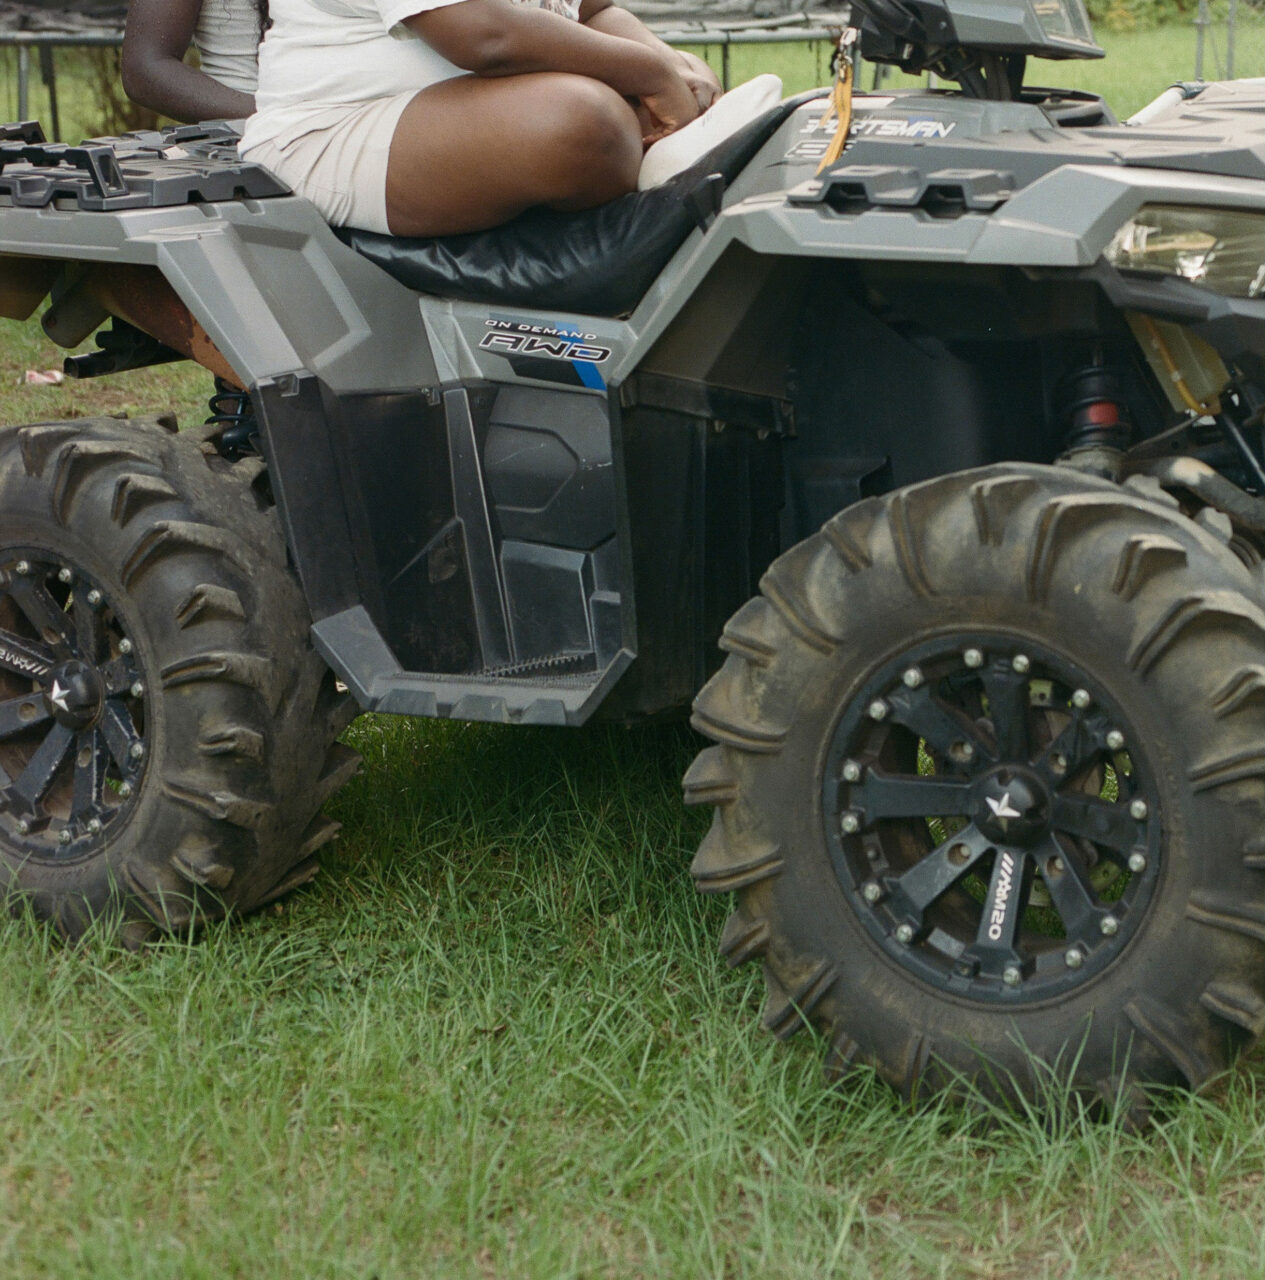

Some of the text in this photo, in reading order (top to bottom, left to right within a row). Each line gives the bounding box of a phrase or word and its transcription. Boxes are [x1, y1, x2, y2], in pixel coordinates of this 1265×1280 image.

[485, 319, 598, 341] ON DEMAND
[479, 331, 612, 363] AWD
